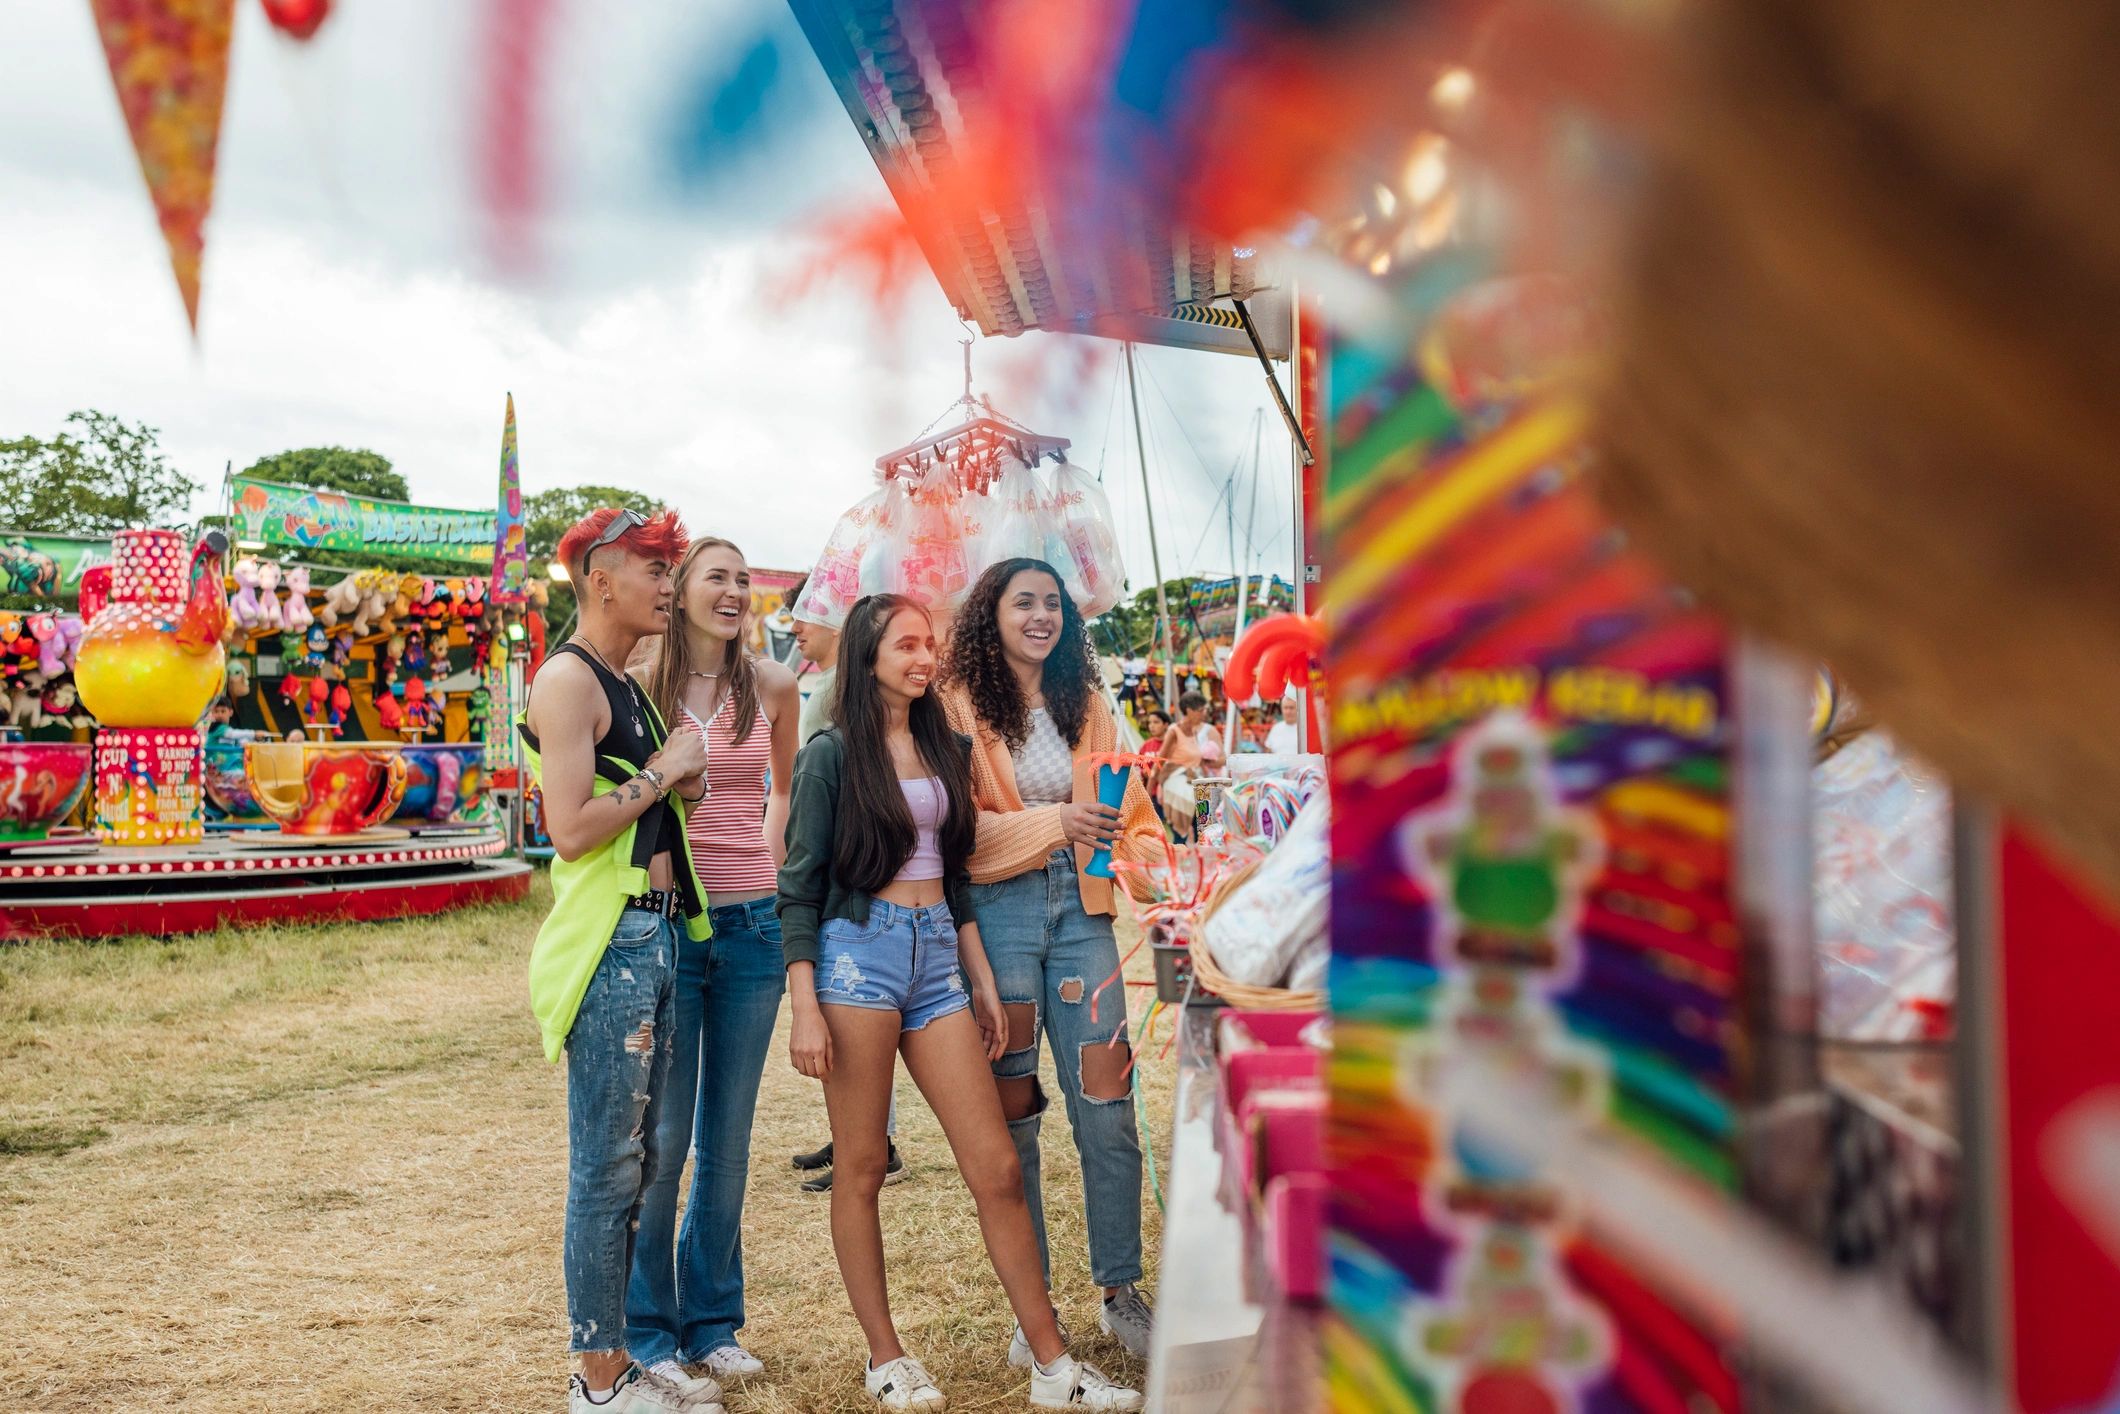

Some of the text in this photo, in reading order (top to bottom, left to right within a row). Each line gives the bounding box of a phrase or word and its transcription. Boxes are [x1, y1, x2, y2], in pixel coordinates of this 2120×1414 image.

[362, 512, 497, 544] BASKETBALL
[100, 748, 129, 770] CUP
[156, 746, 195, 760] WARNING
[160, 760, 191, 772] DO NOT
[157, 785, 173, 797] THE
[157, 797, 195, 810] FROM THE
